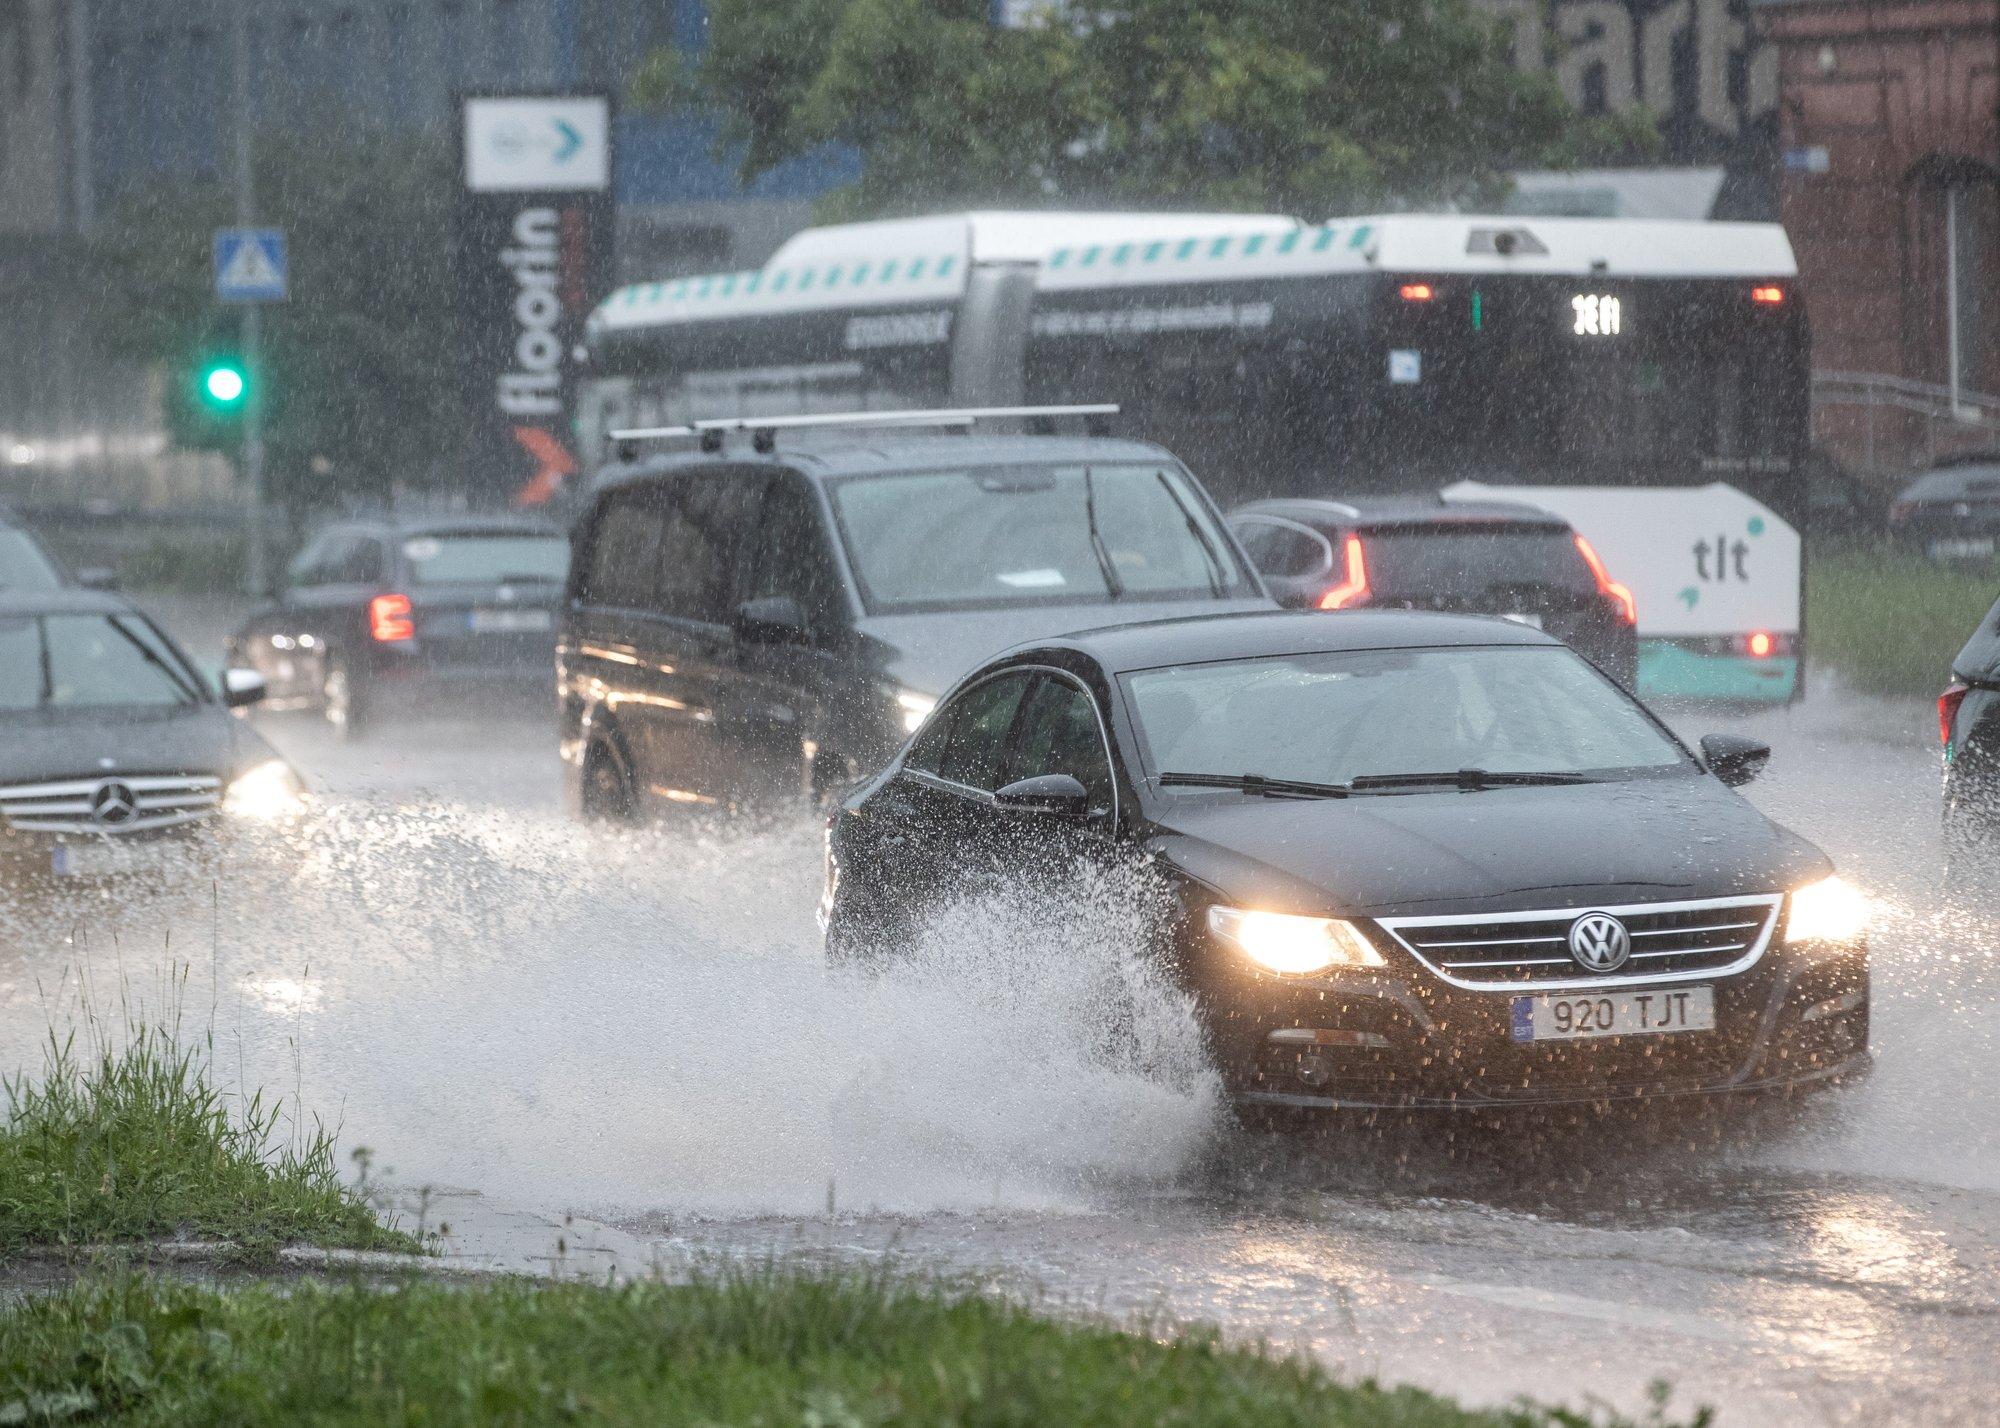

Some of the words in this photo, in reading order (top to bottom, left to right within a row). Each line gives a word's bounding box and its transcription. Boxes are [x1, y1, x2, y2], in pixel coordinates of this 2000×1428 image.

[498, 207, 562, 414] floorin
[1692, 532, 1749, 582] tlt
[1554, 998, 1614, 1033] 920
[1635, 992, 1690, 1028] TJT
